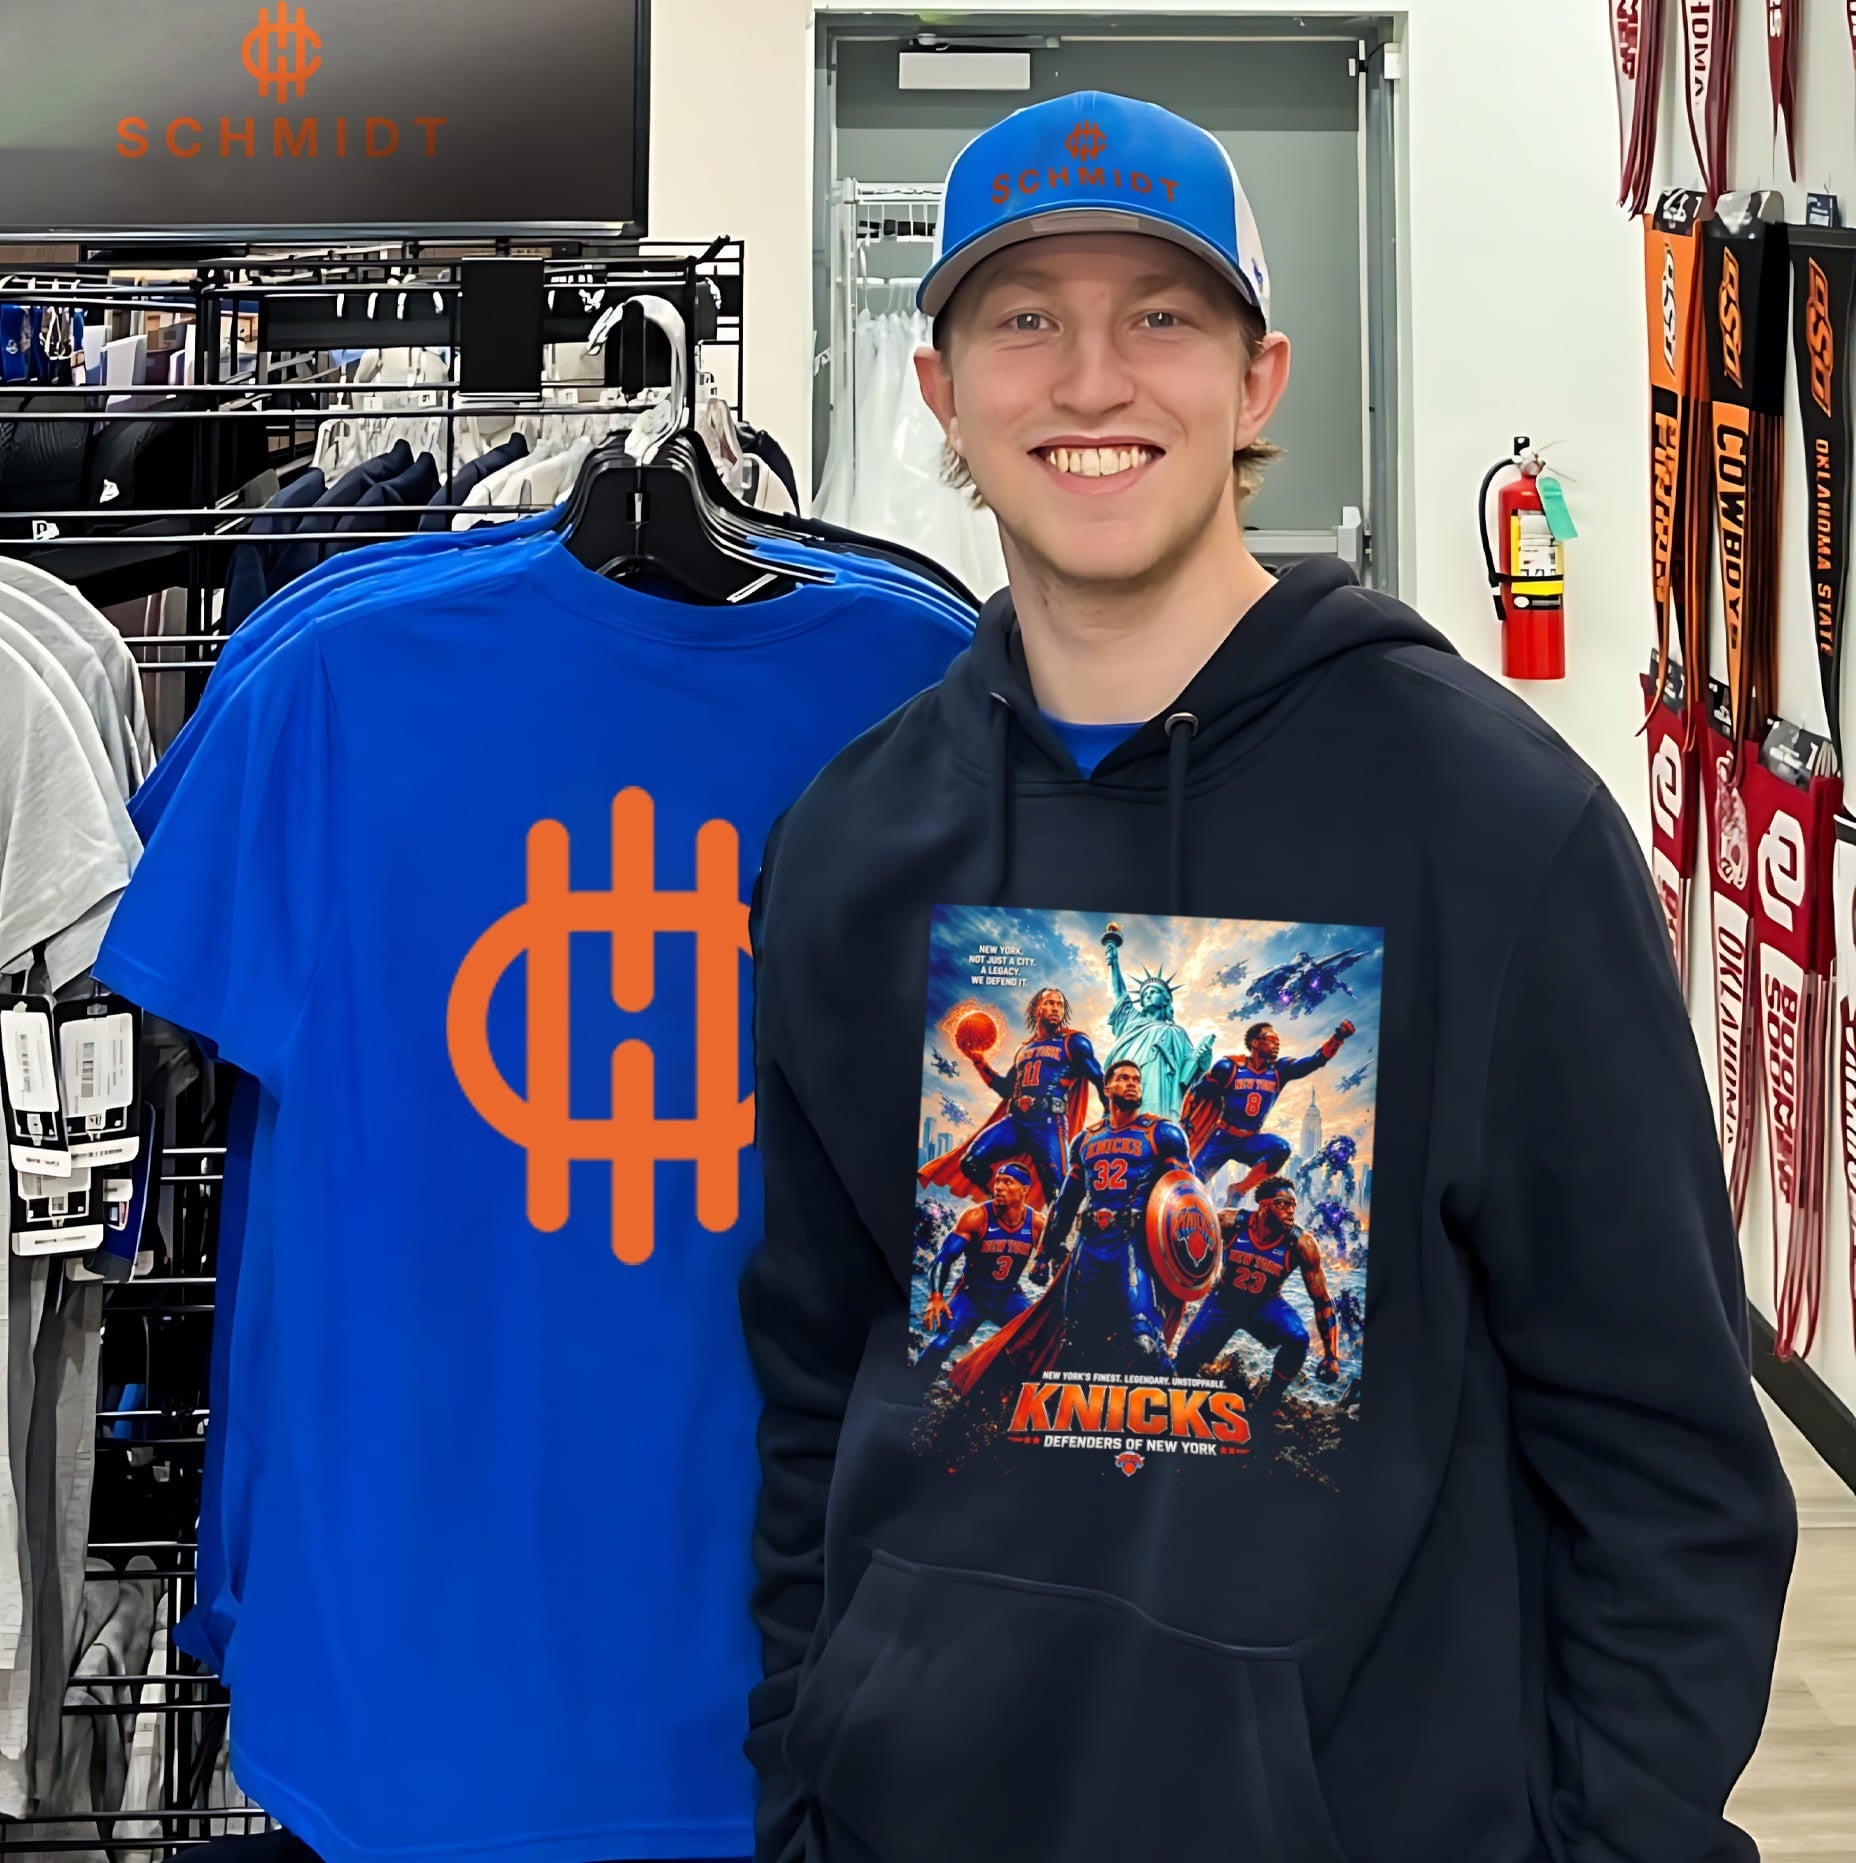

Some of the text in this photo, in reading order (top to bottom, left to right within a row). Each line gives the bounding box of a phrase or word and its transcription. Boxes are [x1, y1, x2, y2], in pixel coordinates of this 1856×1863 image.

[115, 116, 448, 159] SCHMIDT
[991, 166, 1180, 205] SCHMIDT
[1815, 438, 1832, 570] OKLAHOMA
[969, 955, 1036, 966] NOT JUST A CITY.
[979, 945, 998, 954] NEW
[971, 976, 1028, 987] WE DEFEND IT.
[980, 966, 1021, 976] A LEGACY.
[1718, 925, 1744, 1144] OKLAHOMA
[1022, 1060, 1041, 1087] 11
[1245, 1092, 1262, 1117] 8
[1085, 1137, 1142, 1160] KNICKS
[1093, 1158, 1128, 1191] 32
[992, 1255, 1013, 1280] 3
[1233, 1266, 1267, 1294] 23
[1042, 1371, 1227, 1389] NEW YORK'S FINEST. LEGENDARY. UNSTOPPABLE.
[1007, 1382, 1251, 1444] KNICKS
[1043, 1435, 1217, 1456] DEFENDERS OF NEW YORK
